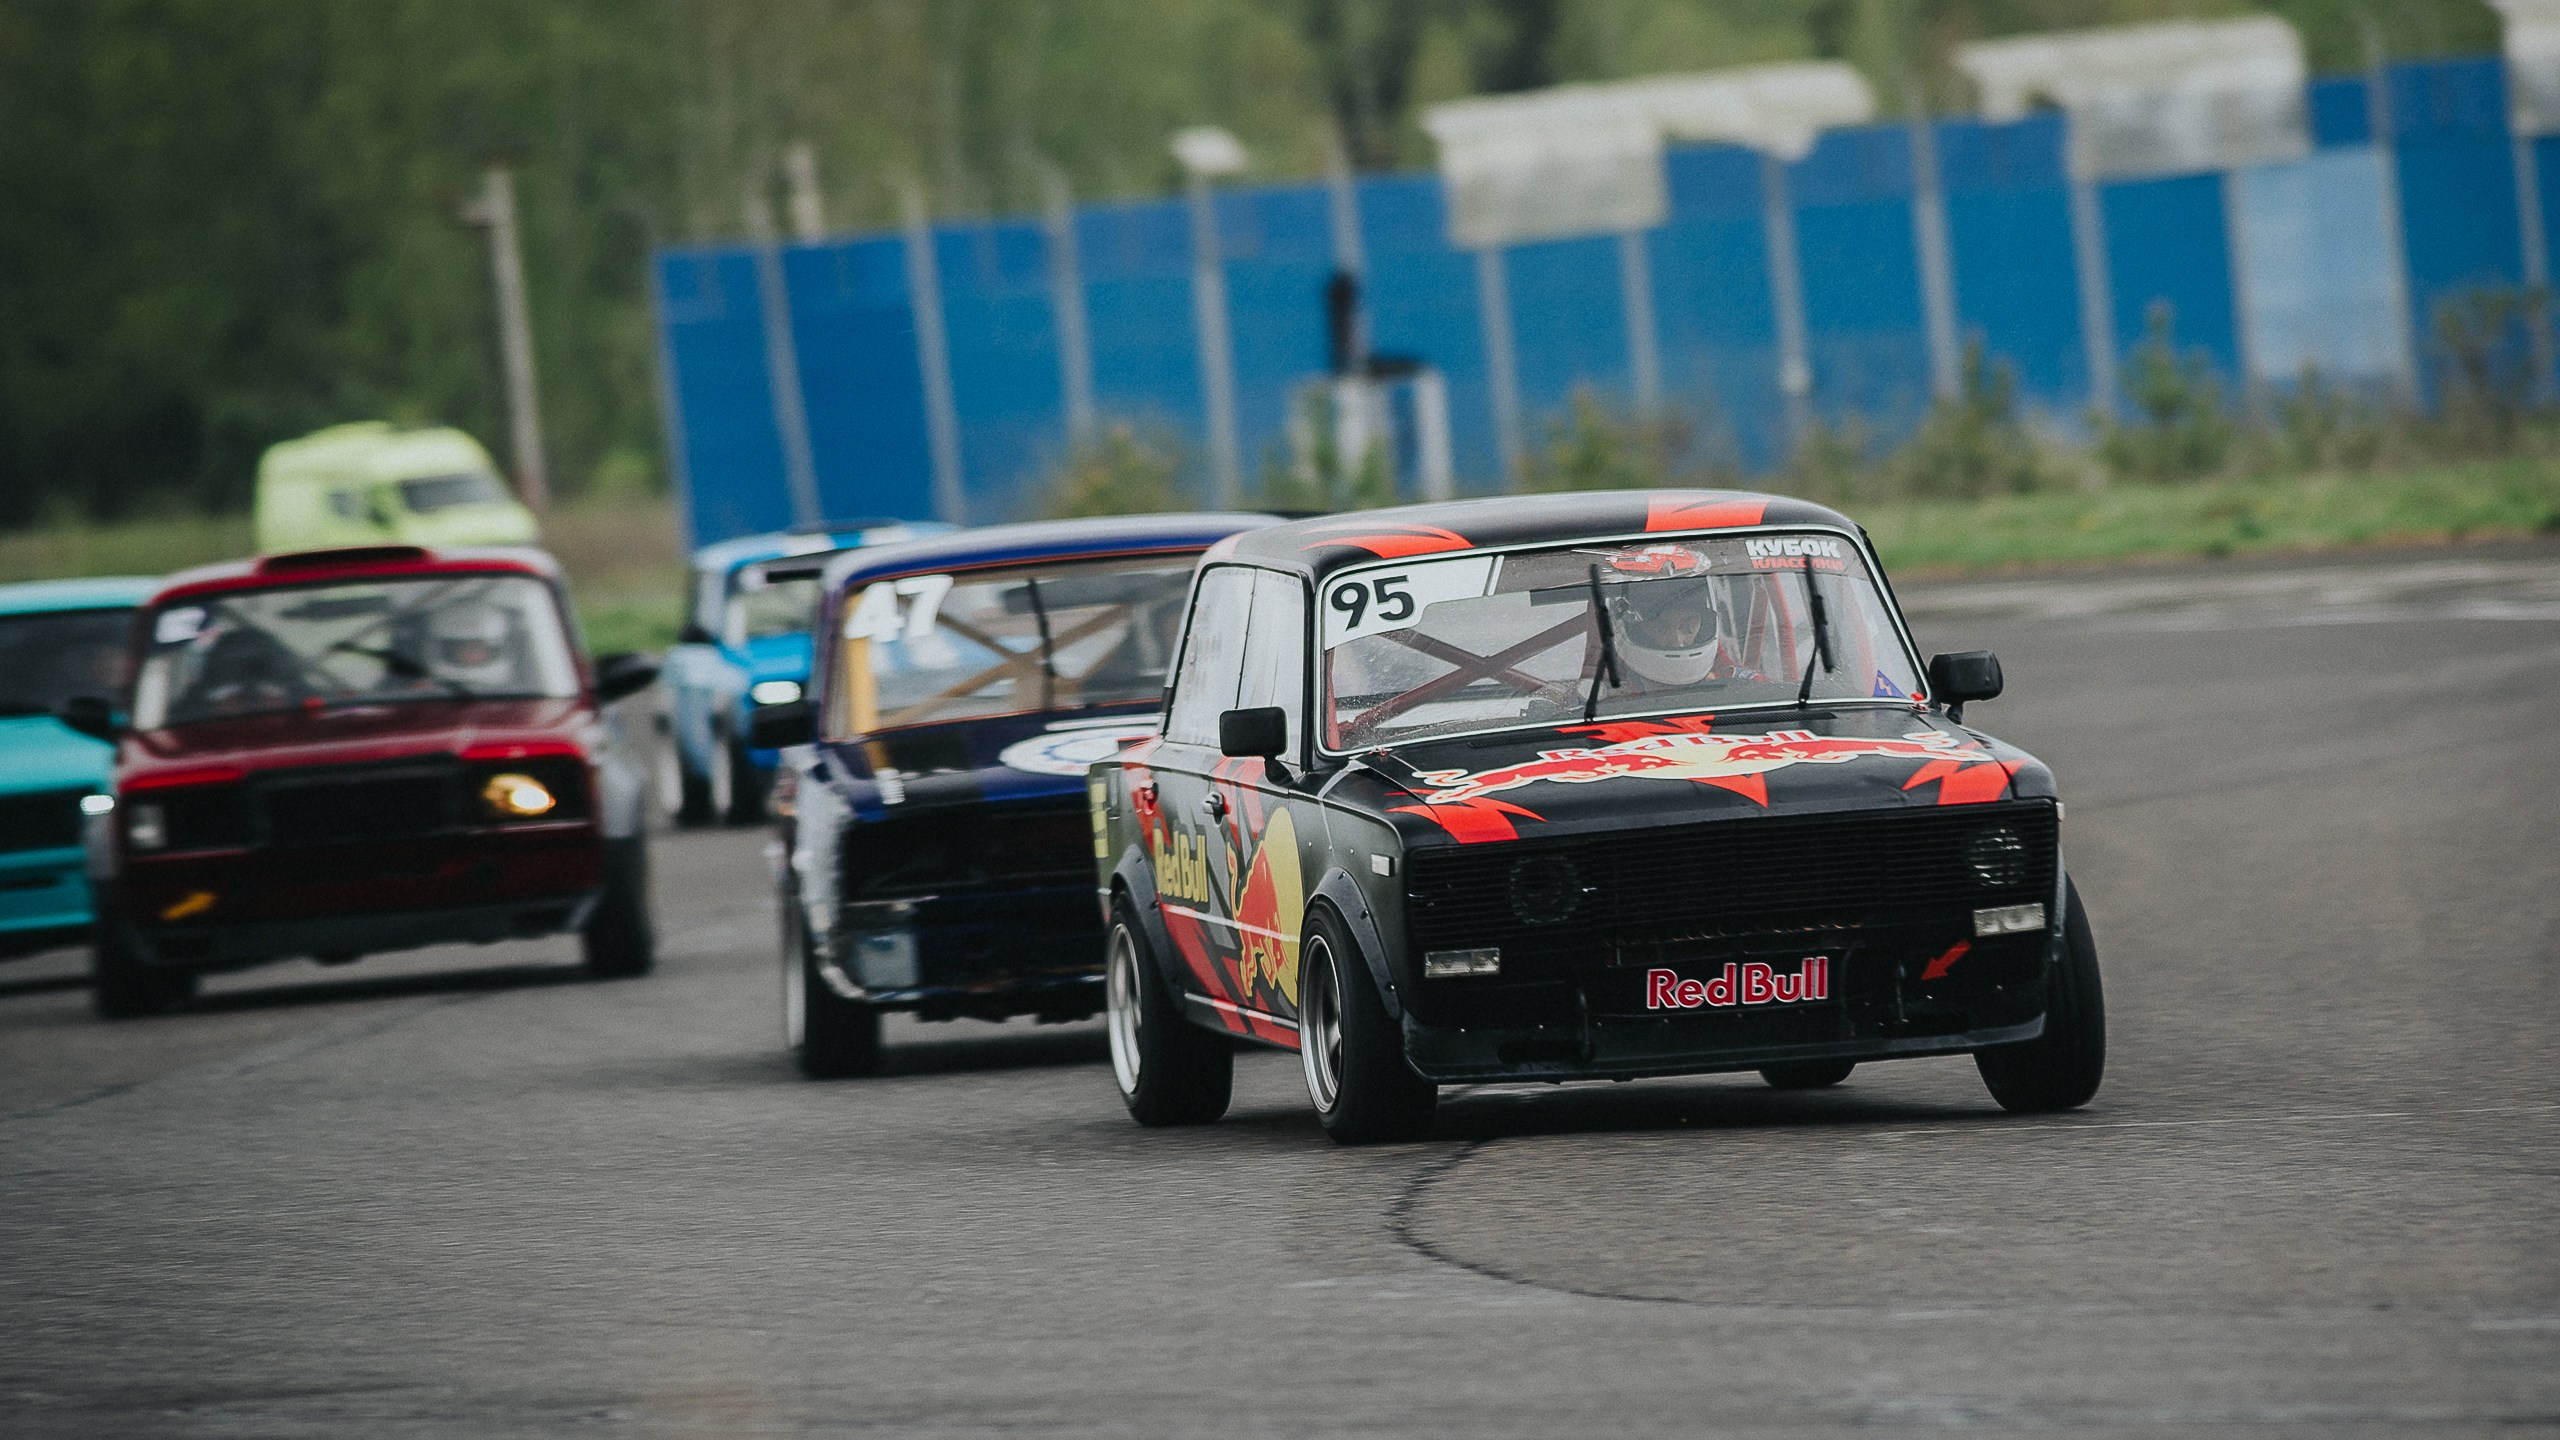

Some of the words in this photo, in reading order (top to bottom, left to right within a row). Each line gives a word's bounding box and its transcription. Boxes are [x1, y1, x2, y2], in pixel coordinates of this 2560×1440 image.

[1745, 540, 1840, 557] КУБОК
[844, 574, 954, 643] 47
[1330, 574, 1414, 632] 95
[1538, 736, 1673, 763] Red
[1686, 730, 1819, 748] Bull
[1647, 963, 1737, 1009] Red
[1742, 956, 1828, 1004] Bull
